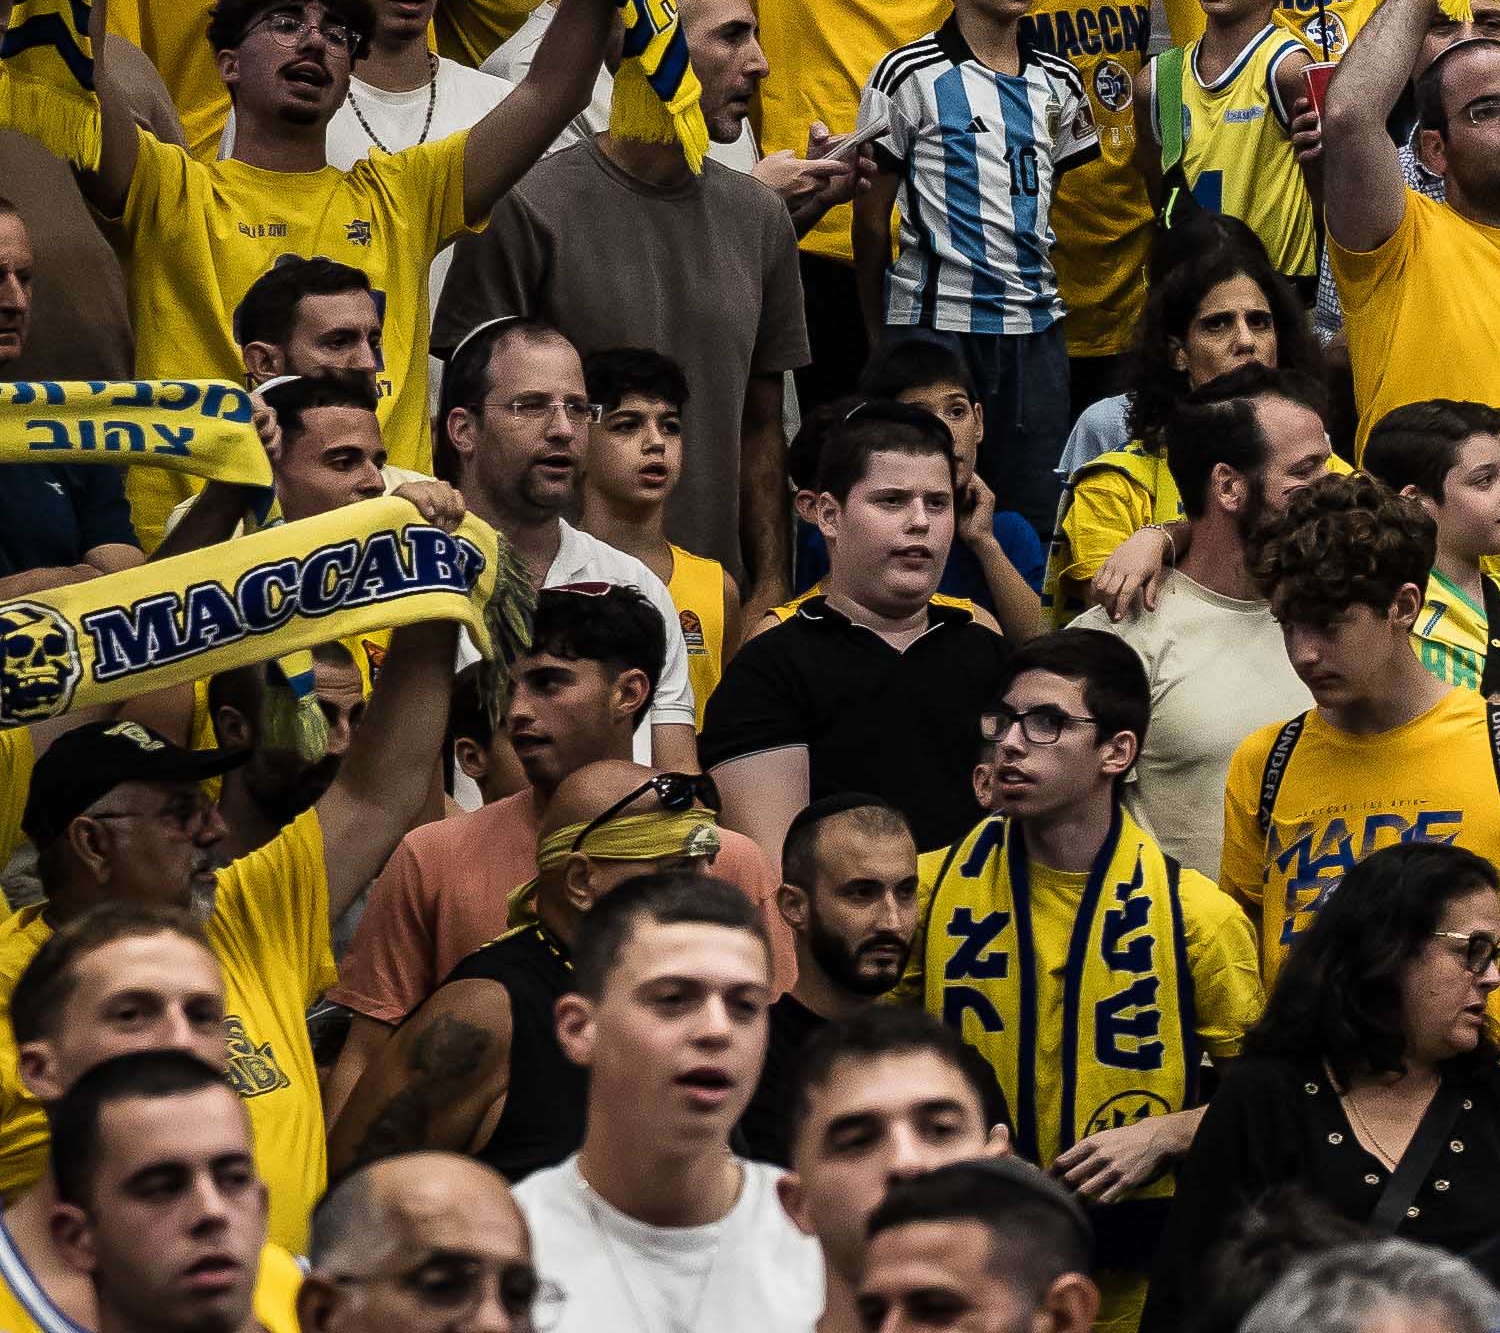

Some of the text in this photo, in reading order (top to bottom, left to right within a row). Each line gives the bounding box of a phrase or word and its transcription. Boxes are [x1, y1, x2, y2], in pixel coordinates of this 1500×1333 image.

[1005, 144, 1041, 197] 10
[26, 418, 196, 459] צהוב
[83, 522, 485, 682] MACCABI
